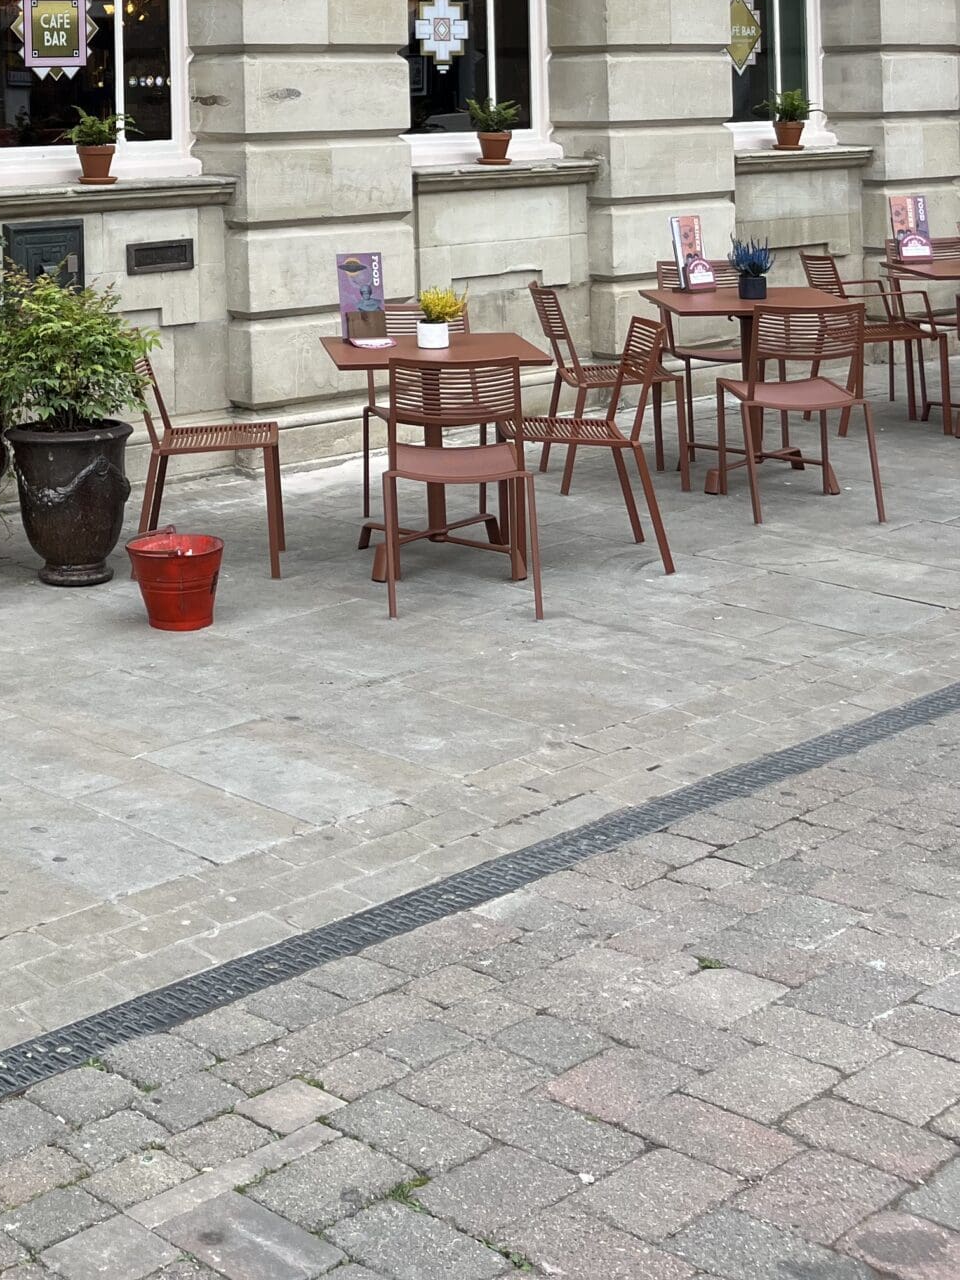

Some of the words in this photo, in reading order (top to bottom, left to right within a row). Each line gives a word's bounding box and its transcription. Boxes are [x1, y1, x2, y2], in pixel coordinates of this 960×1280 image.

[40, 10, 71, 29] CAFÉ
[44, 31, 67, 47] BAR
[741, 26, 756, 37] BAR
[917, 198, 925, 221] FOOD
[371, 255, 380, 287] FOOD
